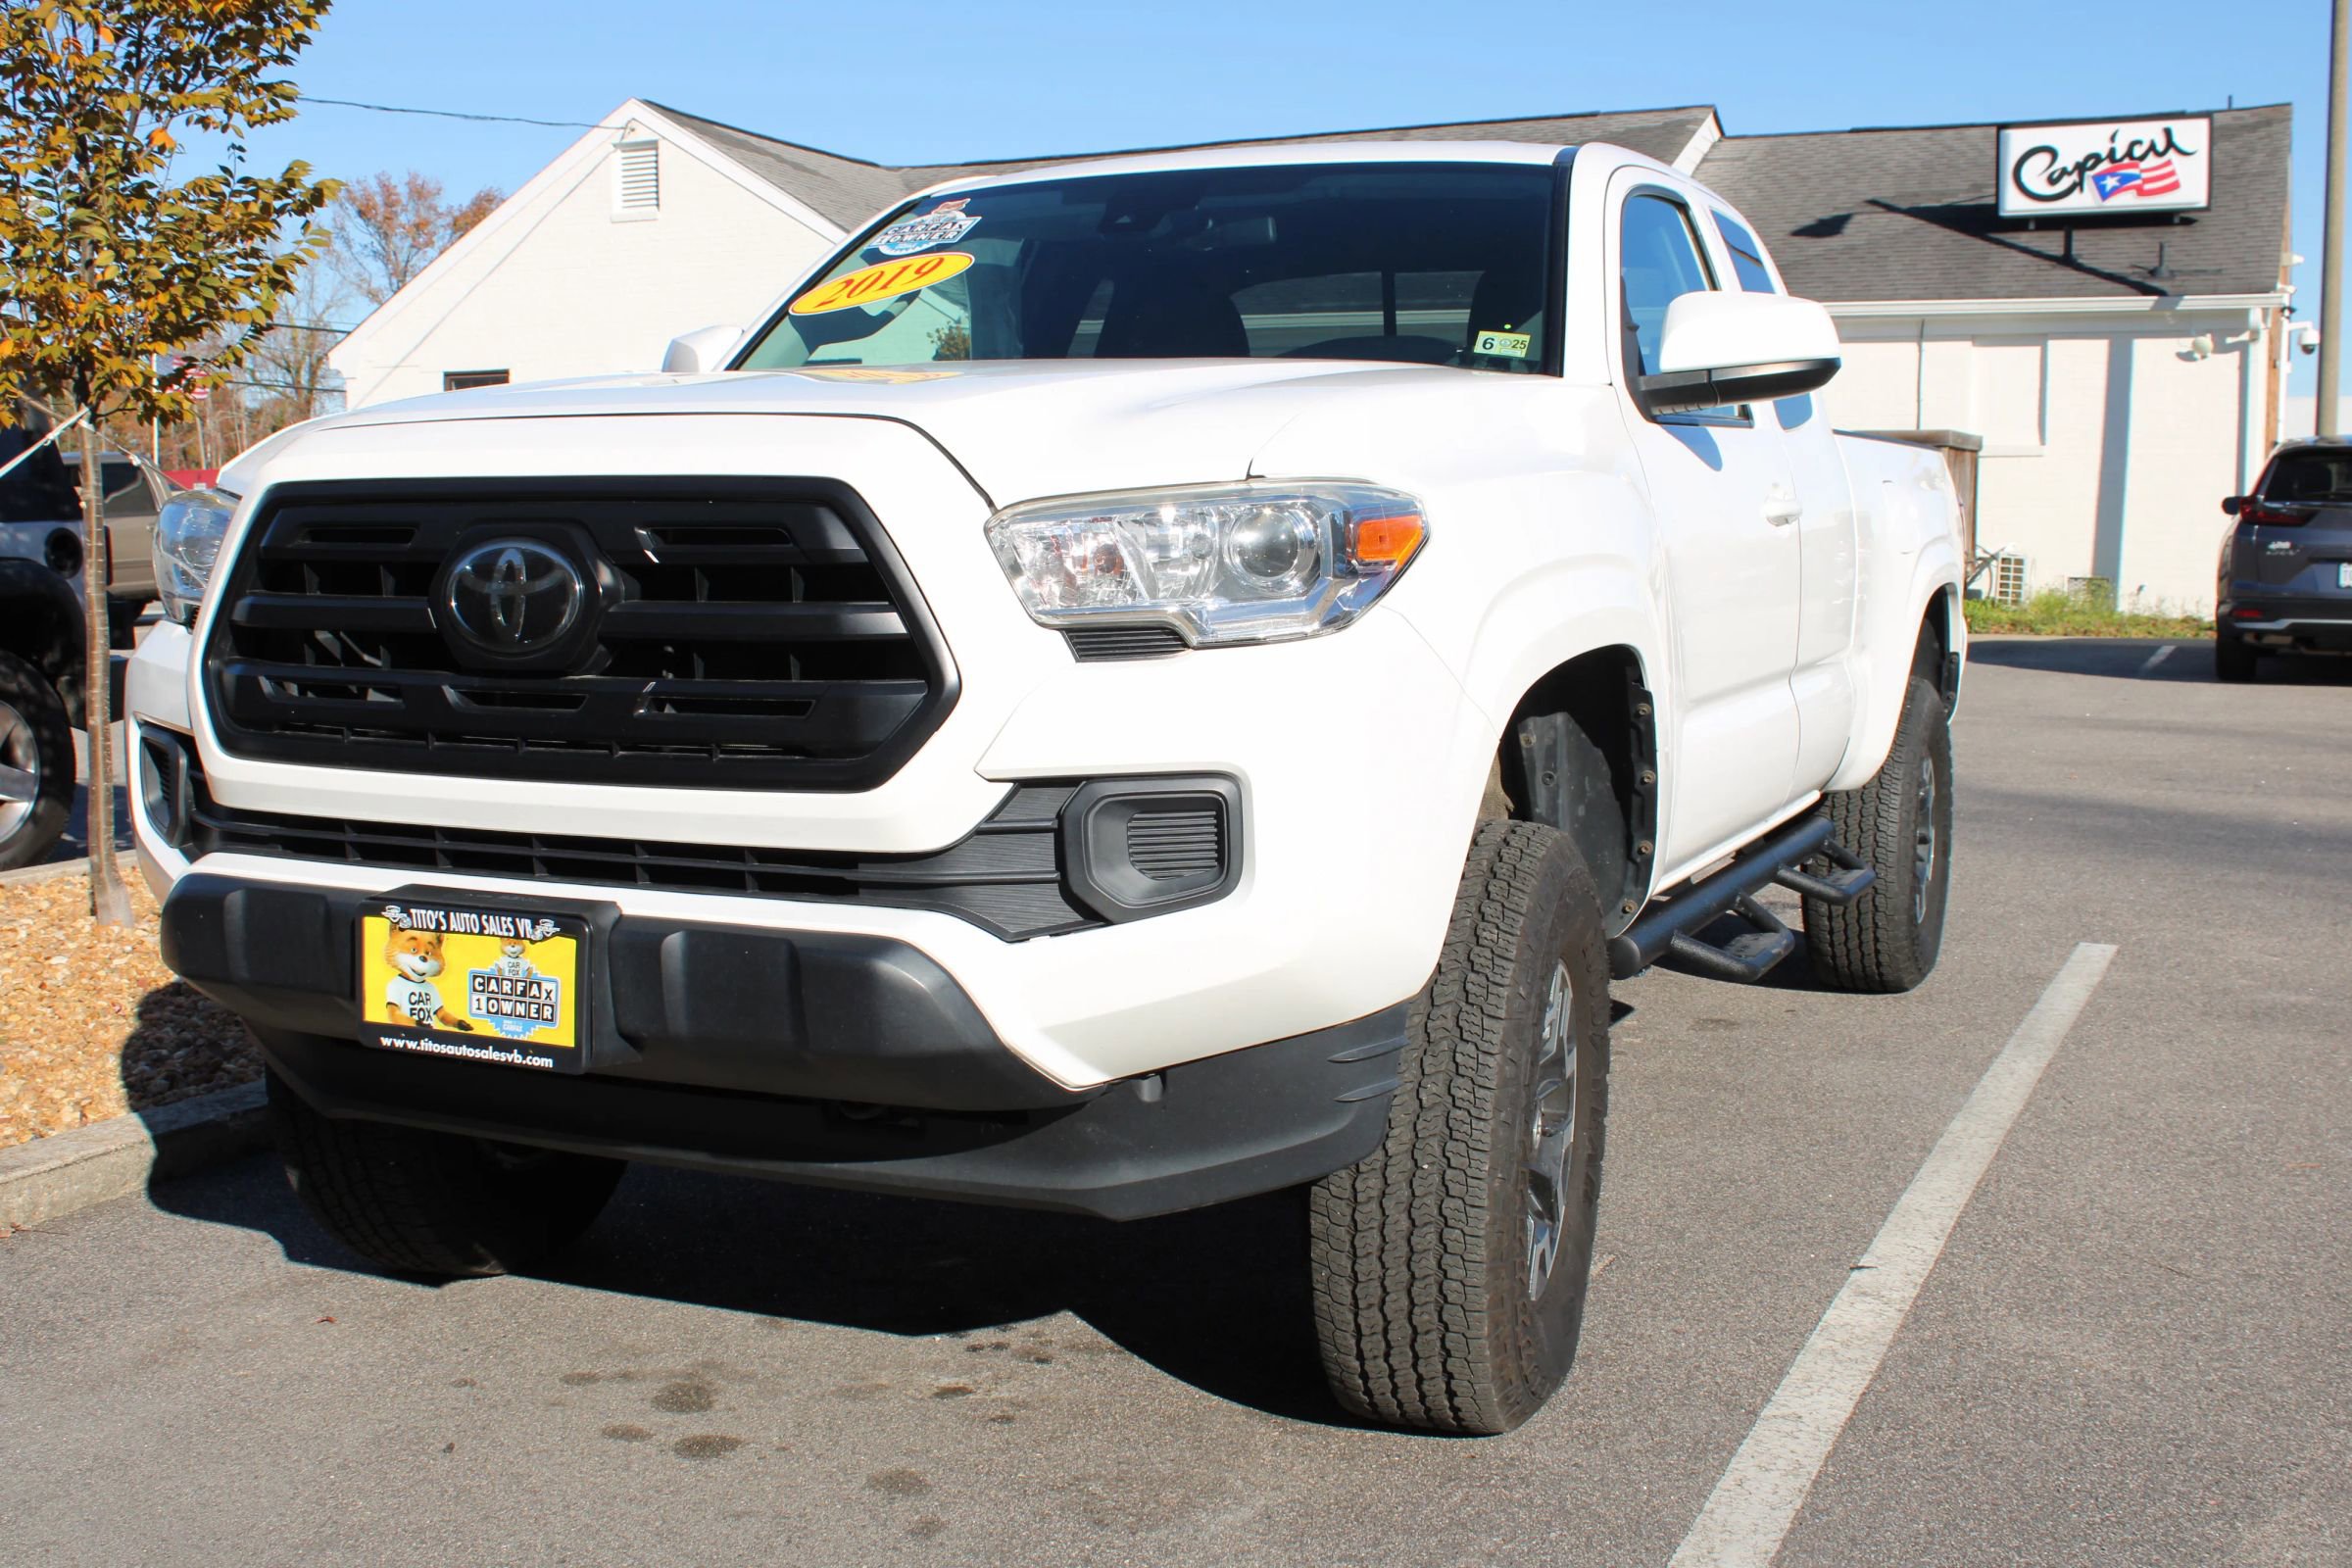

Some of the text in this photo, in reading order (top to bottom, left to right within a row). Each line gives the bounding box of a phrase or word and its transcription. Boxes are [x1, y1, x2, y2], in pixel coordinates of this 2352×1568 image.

[813, 256, 946, 309] 2019
[1482, 337, 1528, 350] 6 25
[410, 907, 448, 931] TITO'S
[450, 911, 480, 933] AUTO
[481, 914, 515, 938] SALES
[408, 991, 432, 1006] CAR
[473, 977, 554, 1001] CARFAX
[410, 1006, 433, 1022] FOX
[379, 1035, 555, 1068] www.titosautosalesvb.com
